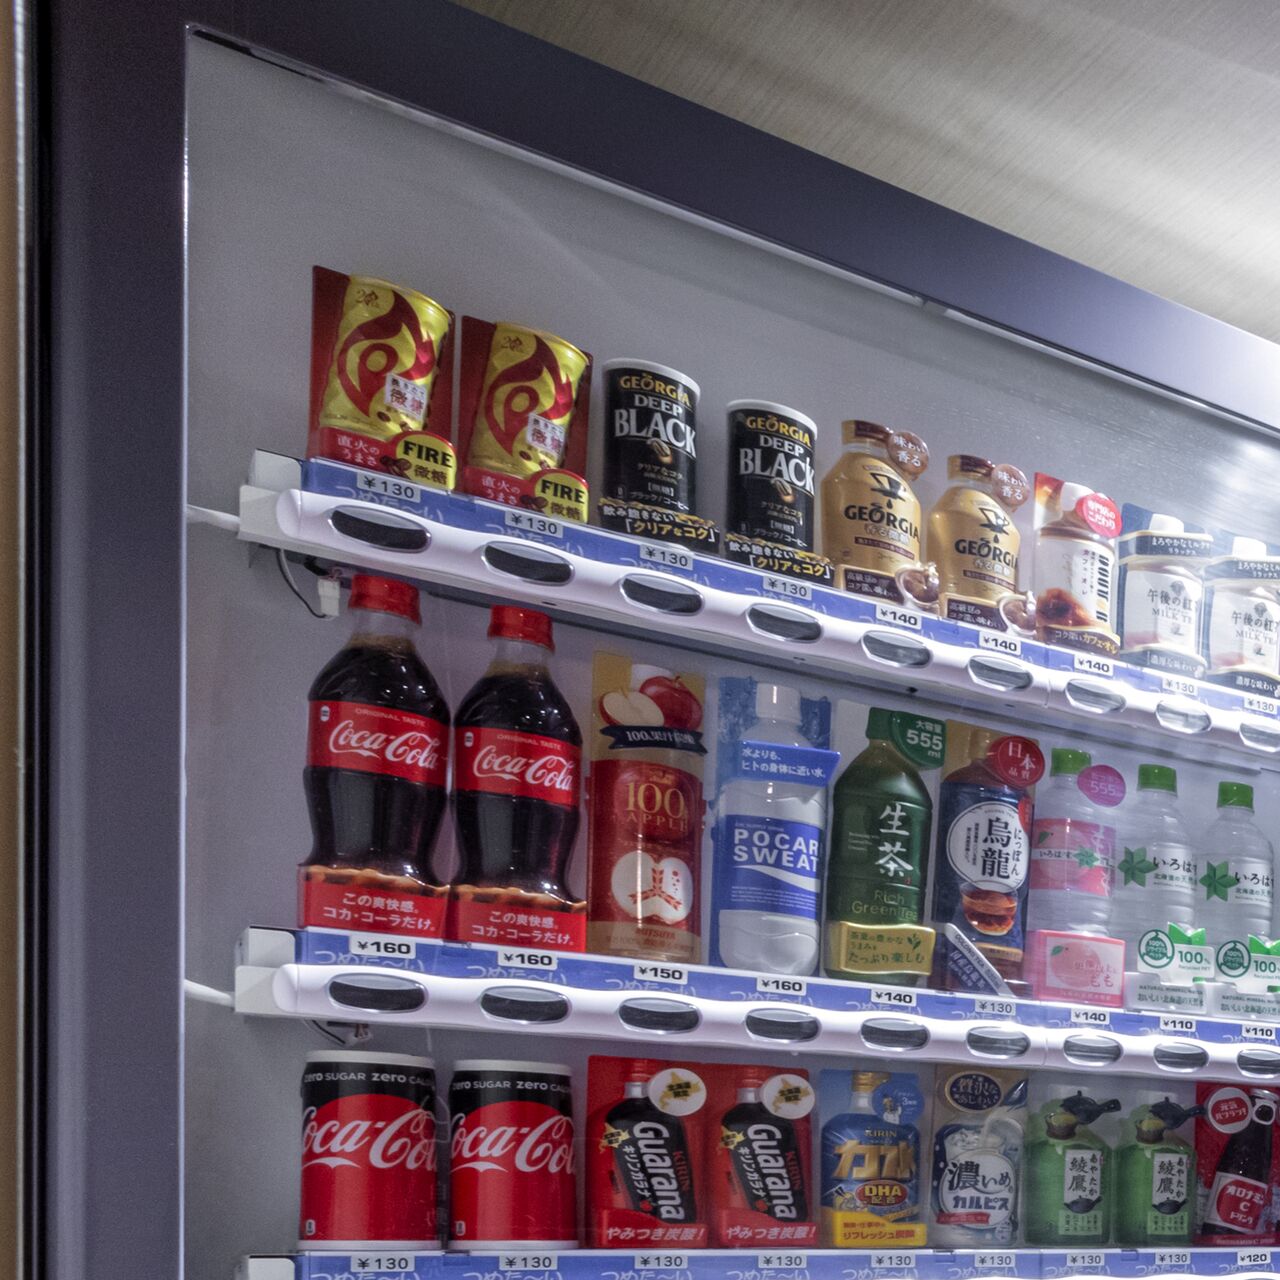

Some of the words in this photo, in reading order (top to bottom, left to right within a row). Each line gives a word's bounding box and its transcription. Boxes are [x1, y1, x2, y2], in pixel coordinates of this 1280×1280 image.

[634, 394, 683, 417] DEEP
[614, 408, 697, 458] BLACK
[336, 434, 380, 455] 直火の
[403, 440, 453, 468] FIRE
[760, 434, 804, 456] DEEP
[341, 449, 377, 467] うまさ
[897, 451, 921, 467] 香る
[413, 464, 448, 486] 微糖
[739, 447, 815, 497] BLACK
[998, 471, 1026, 487] 味わい
[481, 475, 520, 495] 直火の
[540, 479, 585, 504] FIRE
[1003, 486, 1023, 500] 香る
[844, 502, 921, 541] GEORGIA
[329, 720, 441, 769] Coca-Cola
[907, 730, 943, 750] 555
[473, 745, 575, 791] Coca-Cola
[627, 814, 688, 832] APPLE
[875, 802, 914, 877] 生茶
[733, 845, 820, 872] SWEAT
[874, 889, 905, 905] Rich
[851, 900, 897, 917] Green
[900, 907, 918, 921] Tea
[325, 1072, 367, 1081] SUGAR
[371, 1072, 407, 1083] zero
[473, 1080, 512, 1089] SUGAR
[516, 1081, 548, 1091] zero
[864, 1129, 897, 1137] KIRIN
[633, 1121, 686, 1220] Guarana
[747, 1123, 798, 1219] Guarana
[1068, 1156, 1091, 1193] 綾鷹
[1156, 1159, 1176, 1195] 綾鷹
[864, 1184, 902, 1197] DHA
[953, 1194, 1009, 1211] カルピス
[1240, 1201, 1251, 1212] C
